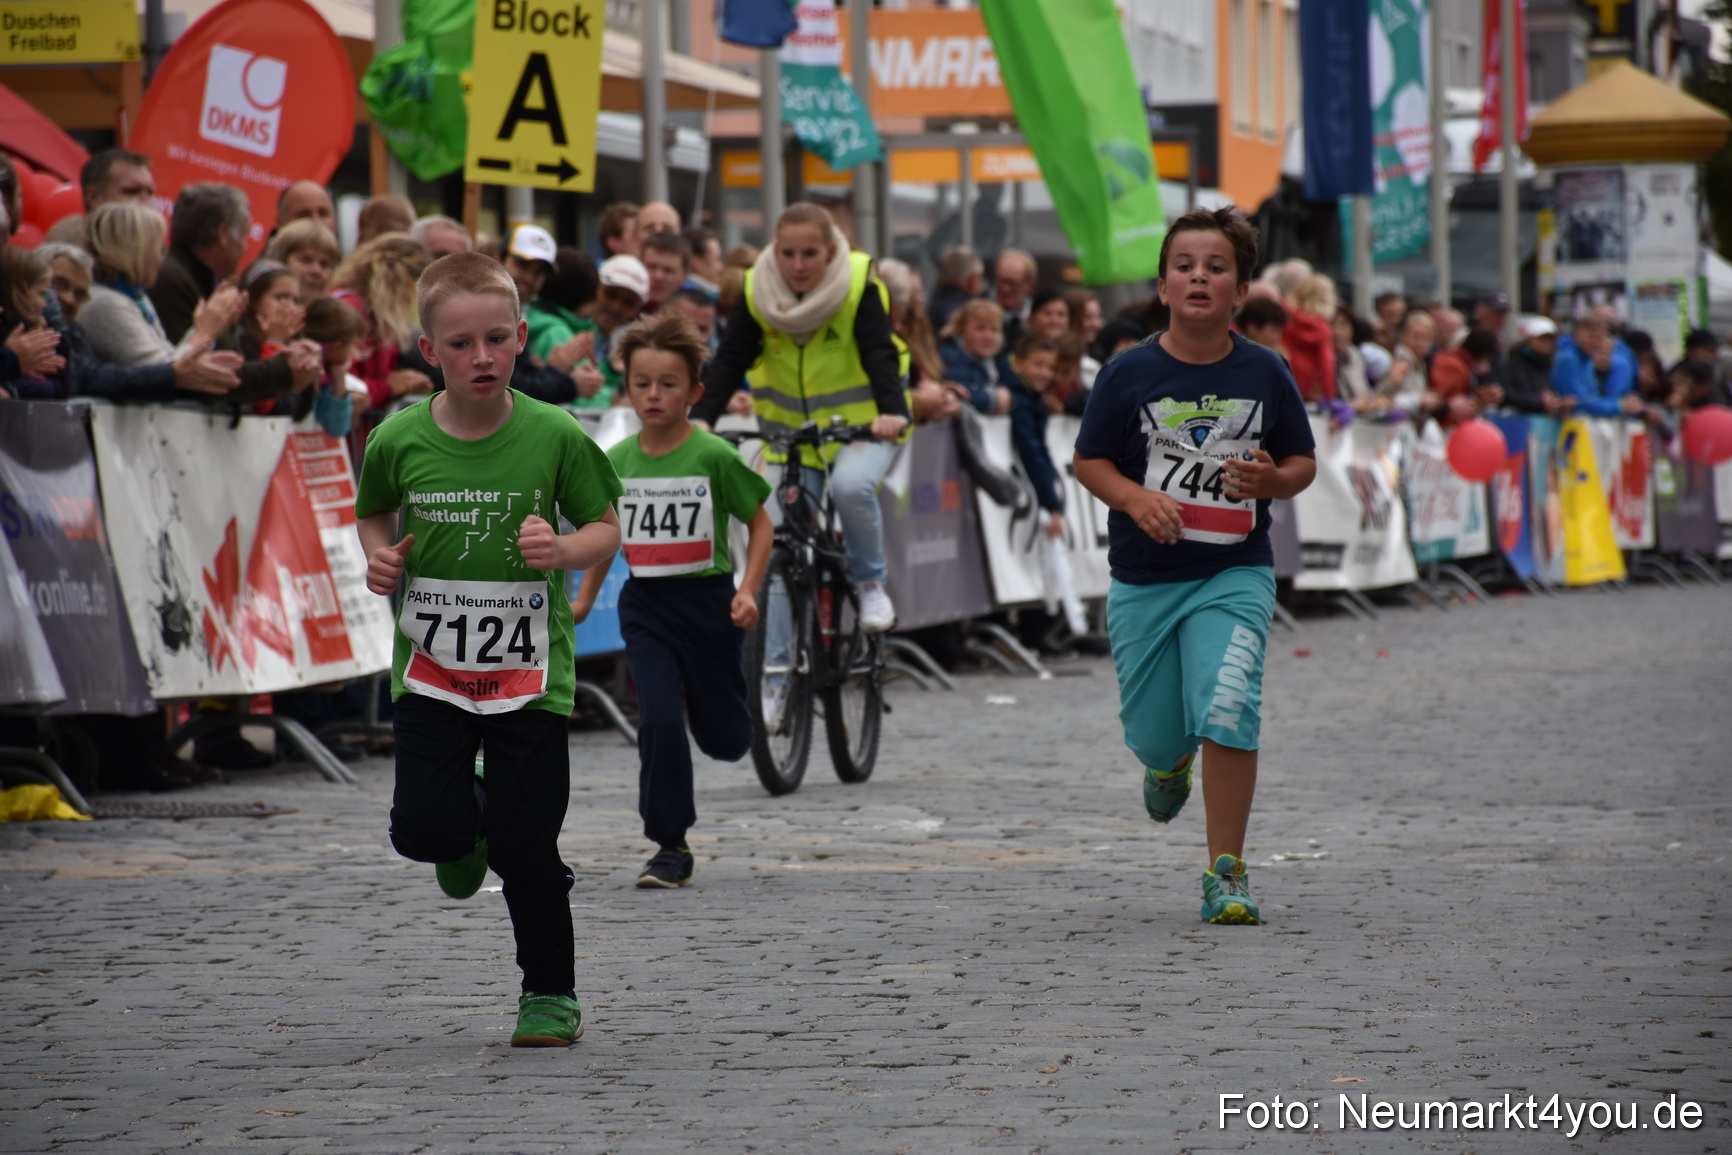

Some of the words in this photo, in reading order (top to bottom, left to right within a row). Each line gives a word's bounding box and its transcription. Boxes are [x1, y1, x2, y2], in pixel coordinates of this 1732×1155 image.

[3, 11, 81, 30] Duschen
[494, 0, 591, 39] Block
[10, 32, 76, 51] Freibad
[497, 52, 568, 147] A
[207, 106, 271, 145] DKMS
[1155, 438, 1195, 454] PAR
[1160, 453, 1244, 504] 744
[408, 488, 501, 504] Neumarkter
[533, 489, 541, 519] BA
[624, 489, 642, 498] RTL
[644, 488, 691, 498] Neumarkt
[413, 506, 480, 526] Stadtlauf
[624, 502, 701, 538] 7447
[407, 590, 451, 606] PARTL
[456, 595, 523, 609] Neumarkt
[415, 612, 536, 664] 7124
[451, 676, 499, 697] Justin
[1207, 623, 1261, 732] BRONX
